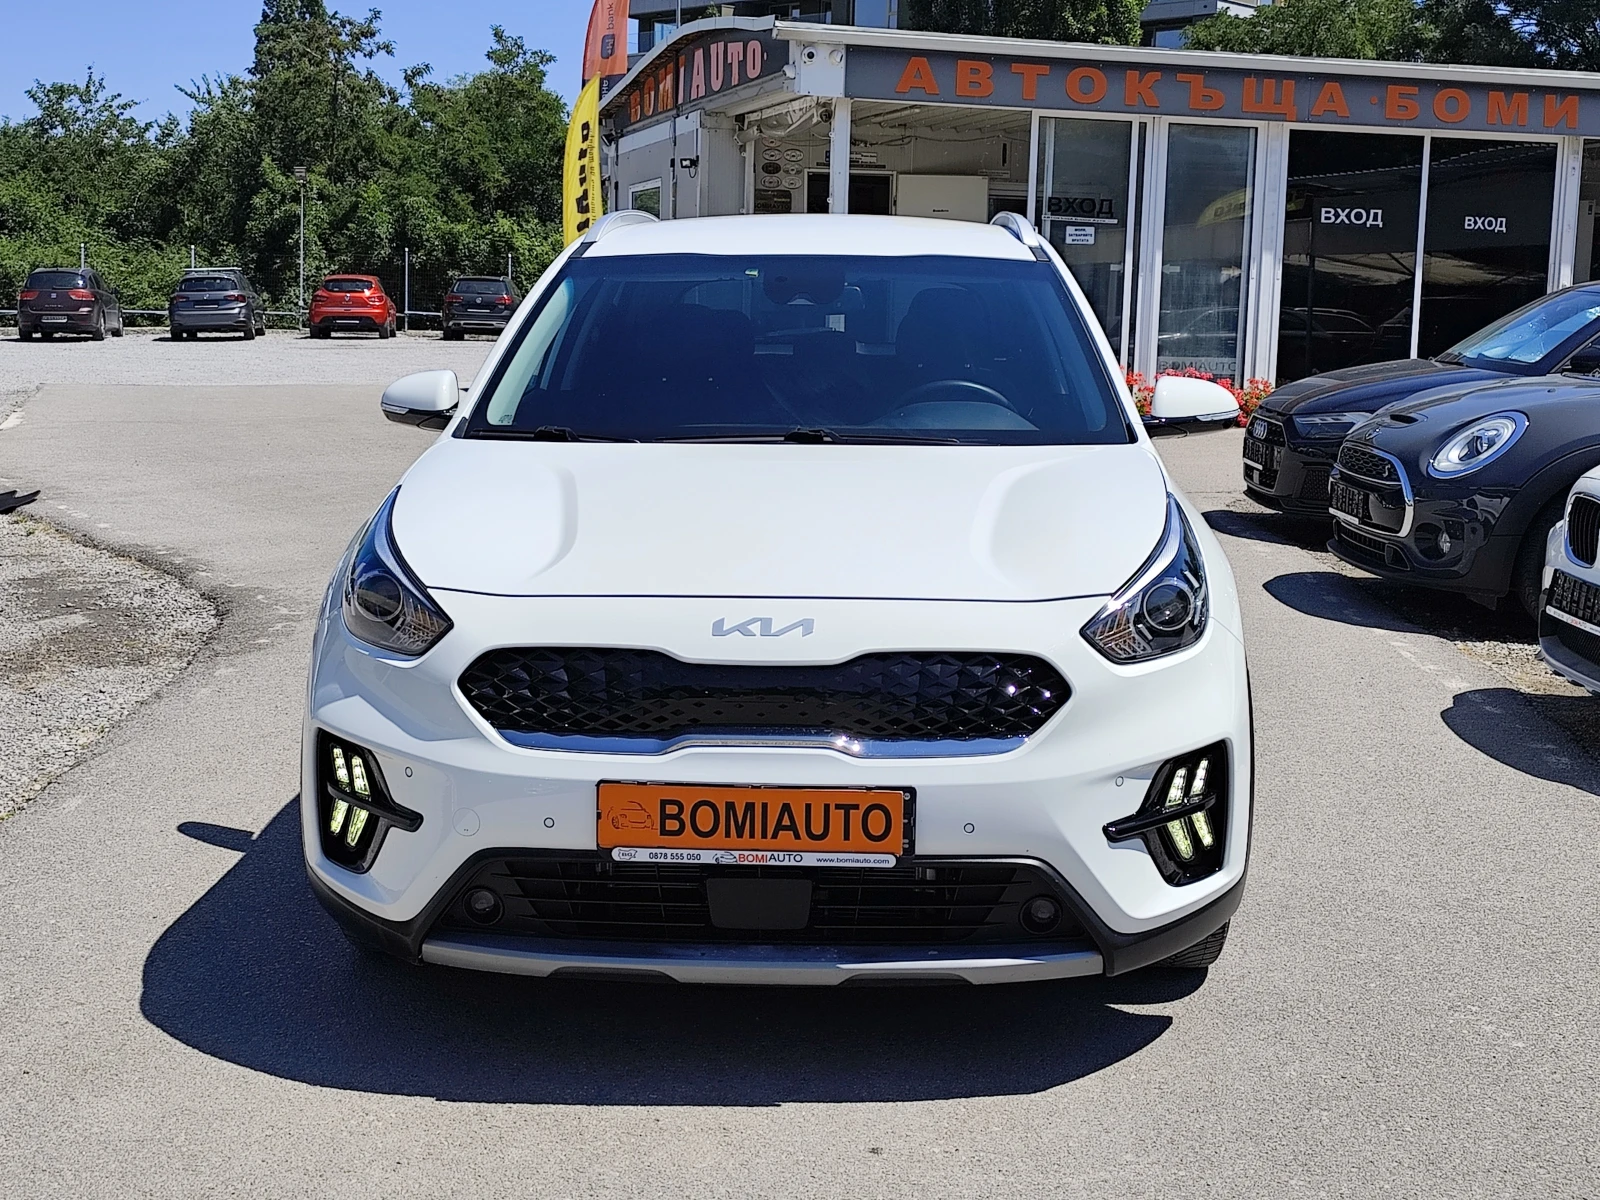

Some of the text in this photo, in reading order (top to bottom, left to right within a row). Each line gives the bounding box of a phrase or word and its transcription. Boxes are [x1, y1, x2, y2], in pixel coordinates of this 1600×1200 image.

[606, 2, 615, 30] bank
[1047, 196, 1115, 217] ВХОД
[1320, 207, 1383, 228] ВХОД
[1464, 216, 1507, 233] ВХОД
[711, 616, 815, 638] KIA
[659, 798, 893, 843] BOMIAUTO
[648, 852, 702, 861] 0878 555 050
[738, 853, 804, 864] BOMIAUTO
[816, 857, 890, 865] www.bomiauto.com
